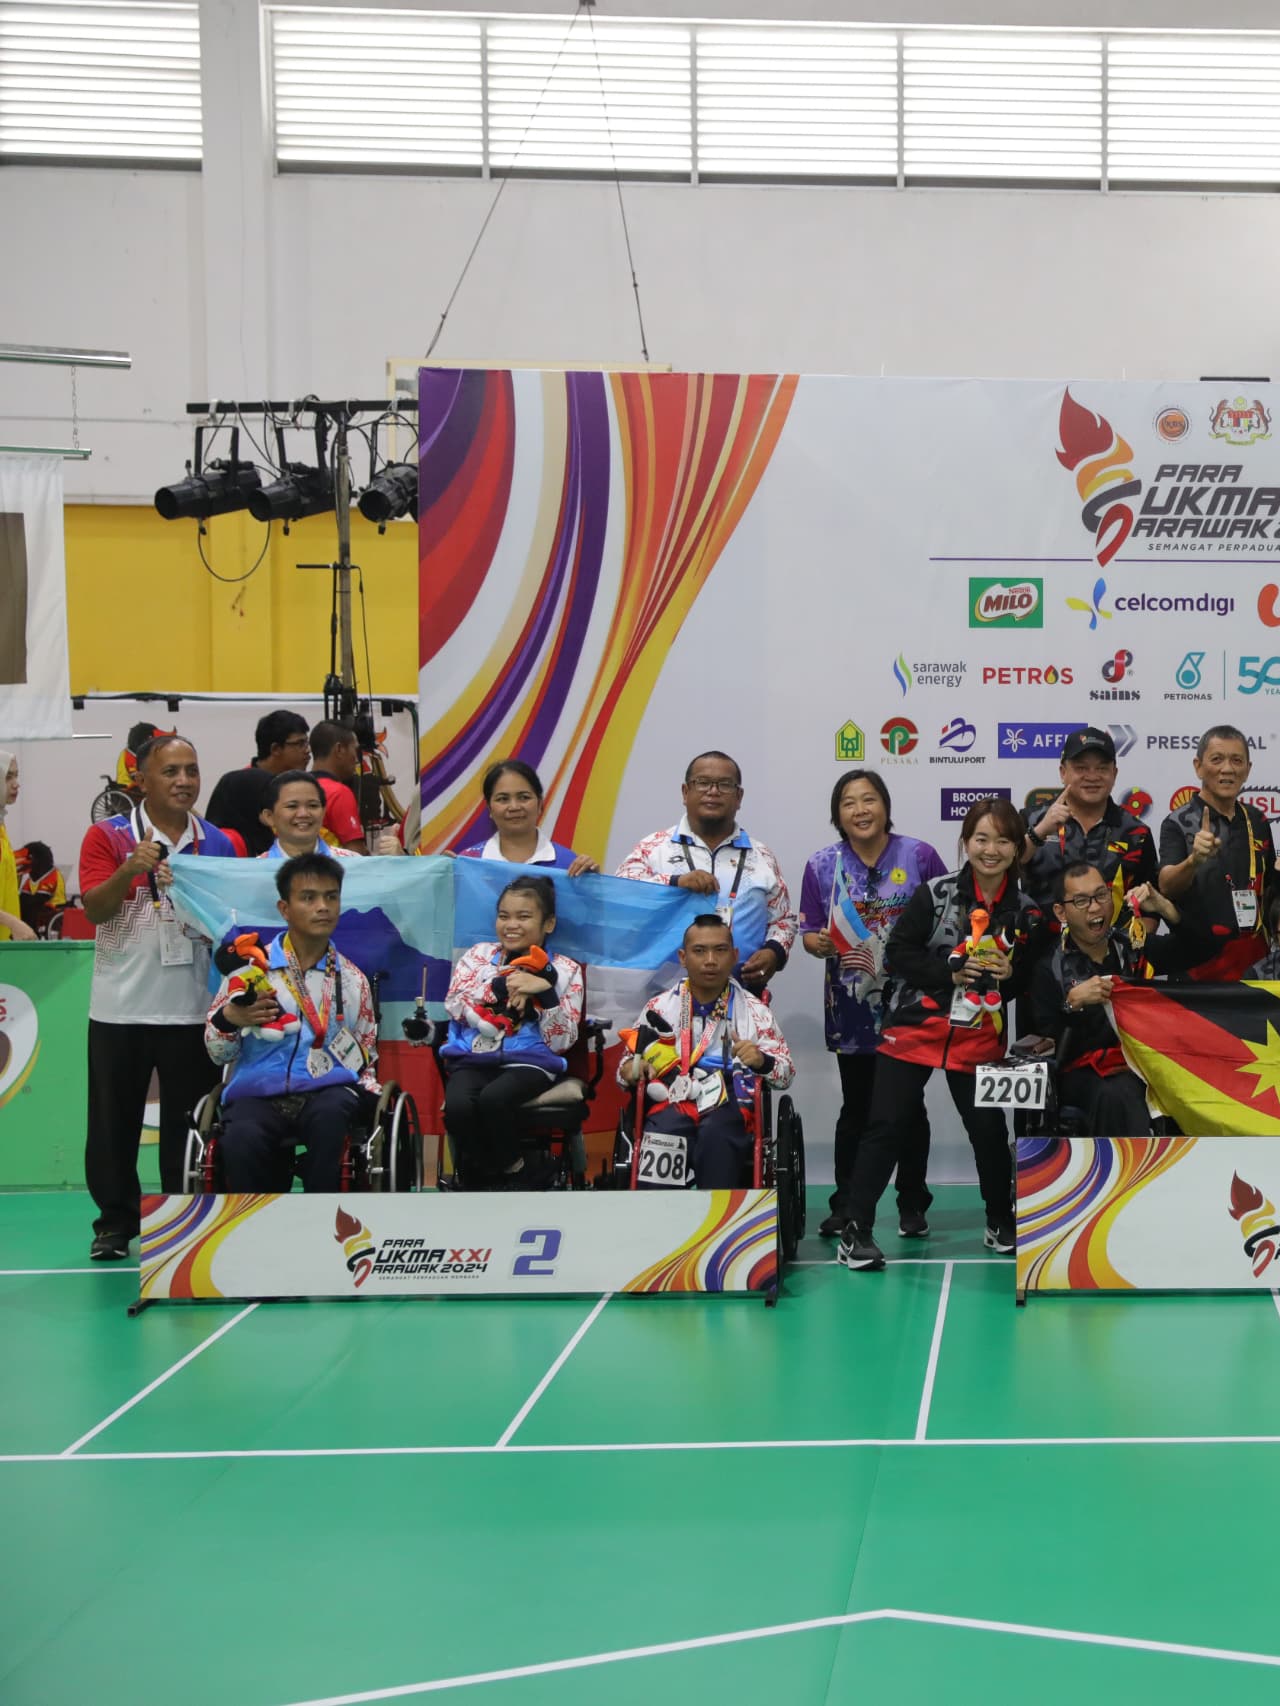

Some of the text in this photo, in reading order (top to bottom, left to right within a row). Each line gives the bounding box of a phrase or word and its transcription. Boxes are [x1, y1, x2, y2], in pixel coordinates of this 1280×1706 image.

[1154, 464, 1243, 483] PARA
[1147, 543, 1213, 552] SEMANGAT
[983, 593, 1033, 613] MILO
[1114, 592, 1235, 616] celcomdigi
[913, 660, 967, 673] sarawak
[917, 674, 962, 688] energy
[983, 665, 1073, 685] PETROS
[1089, 688, 1141, 701] sains
[1164, 693, 1212, 701] PETRONAS
[980, 1076, 1042, 1104] 2201
[640, 1149, 685, 1181] 208
[382, 1239, 425, 1248] PARA
[447, 1248, 492, 1262] XXI
[512, 1230, 562, 1275] 2
[437, 1263, 488, 1273] 2024
